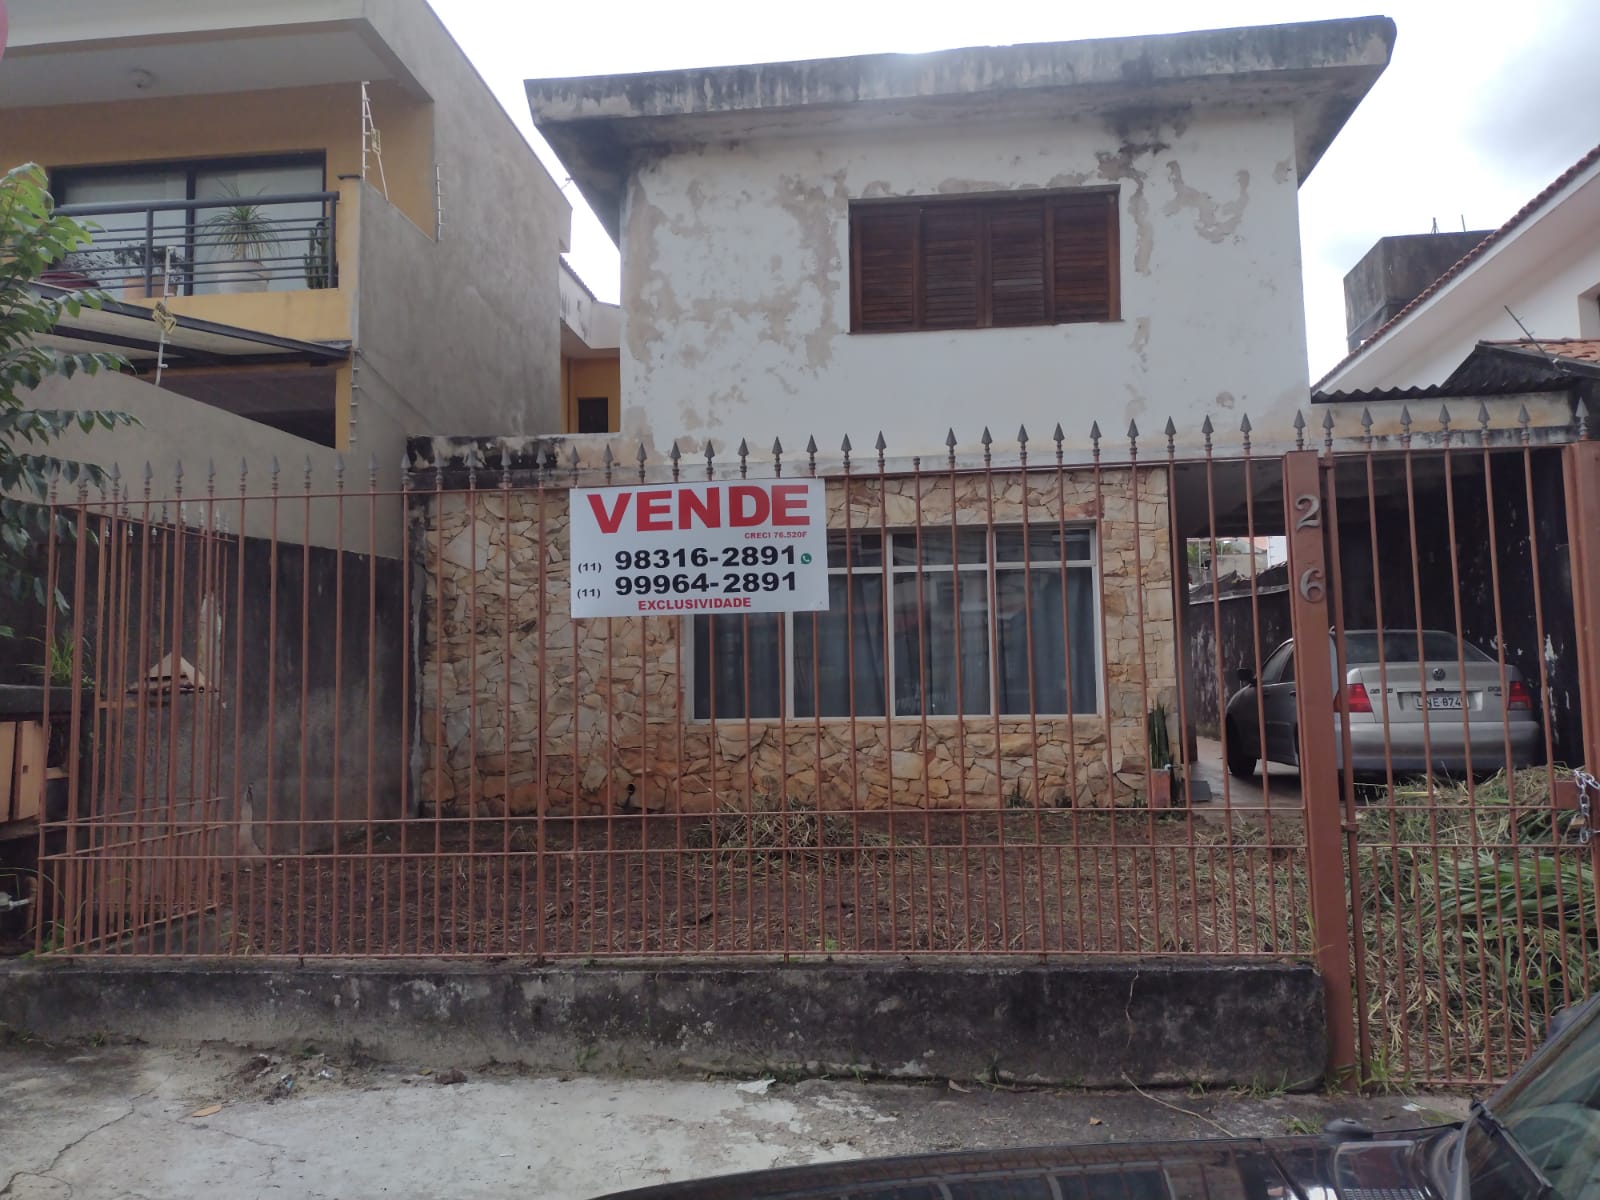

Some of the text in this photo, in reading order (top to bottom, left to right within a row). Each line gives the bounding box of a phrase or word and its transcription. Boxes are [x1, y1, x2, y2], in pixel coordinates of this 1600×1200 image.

[587, 484, 810, 534] VENDE
[577, 545, 795, 573] (11) 98316-2891
[577, 571, 796, 600] (11) 99964-2891
[638, 597, 752, 611] EXCLUSIVIDADE
